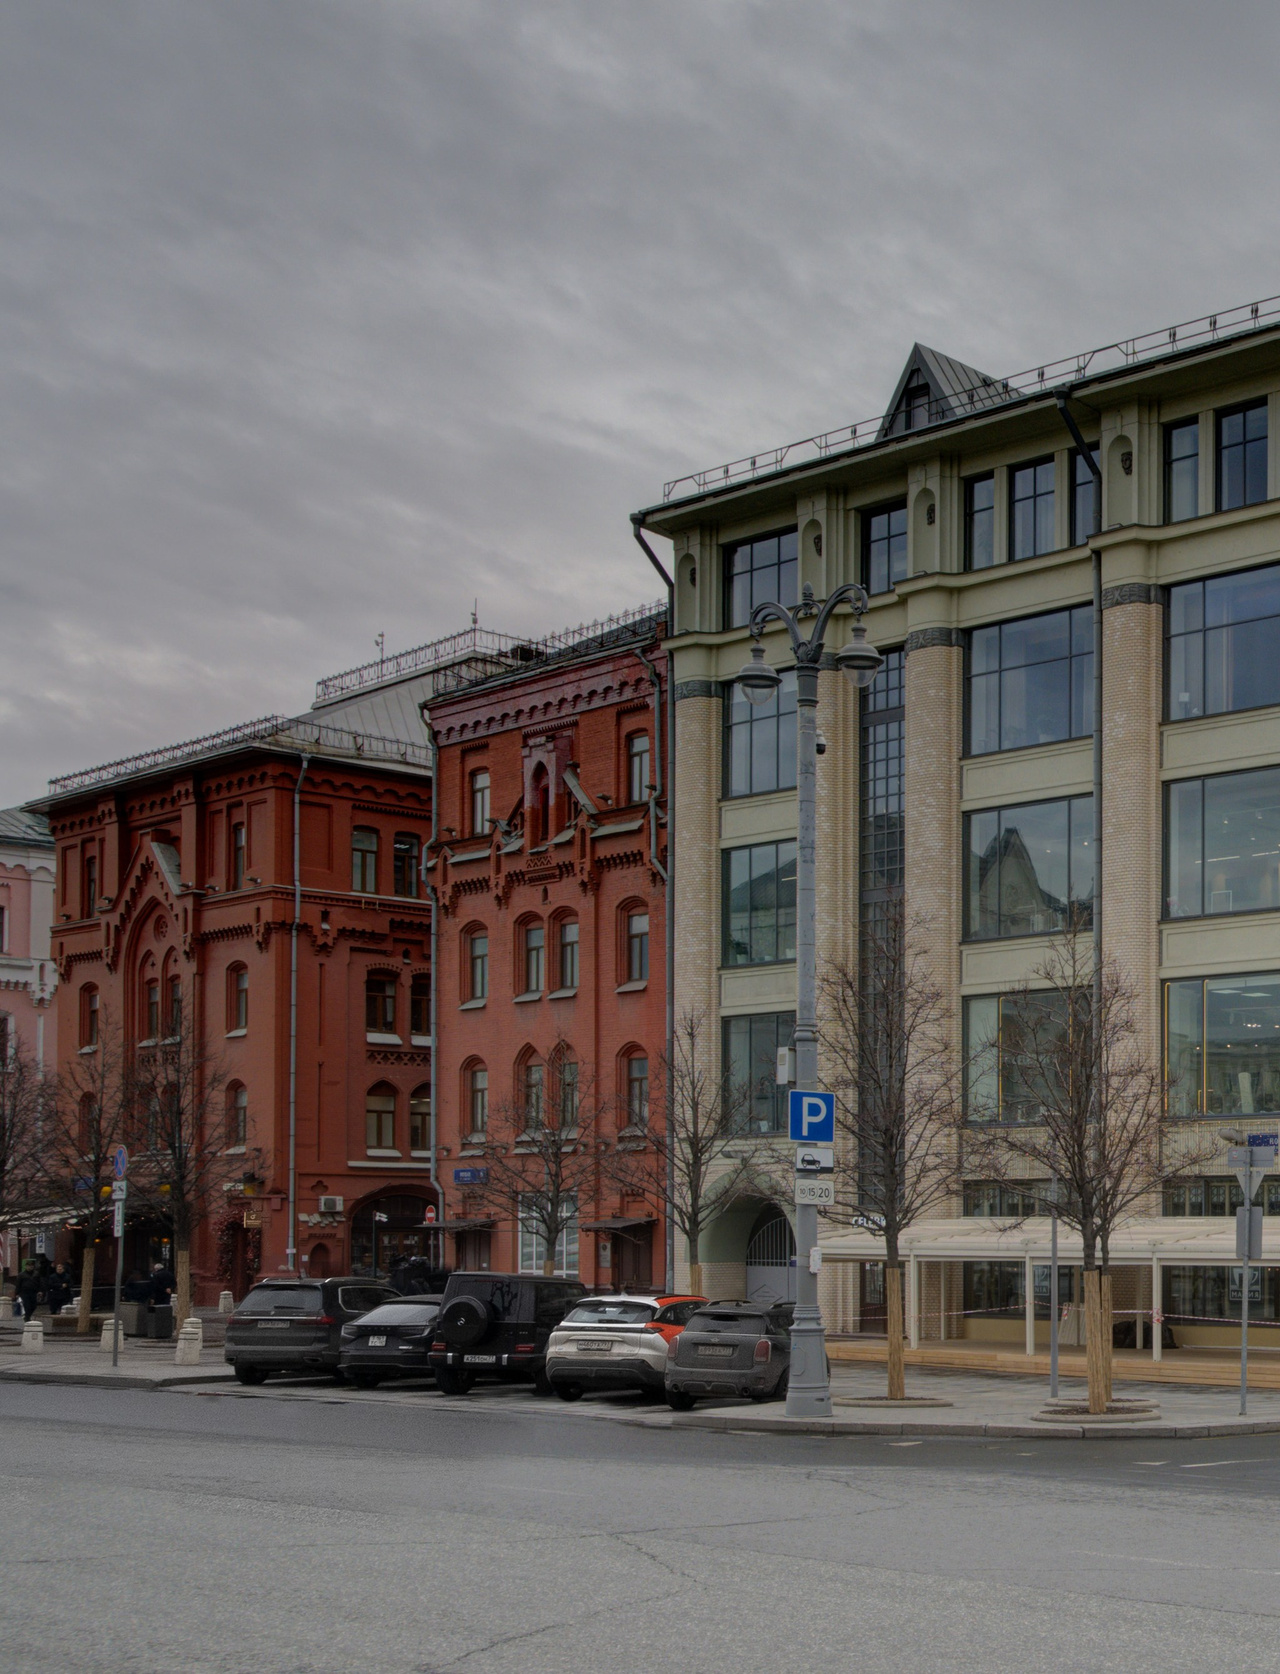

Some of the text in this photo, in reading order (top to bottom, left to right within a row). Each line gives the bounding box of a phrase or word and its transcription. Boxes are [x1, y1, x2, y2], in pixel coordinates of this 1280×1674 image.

[802, 1096, 827, 1136] P
[799, 1187, 830, 1198] 10 15 20
